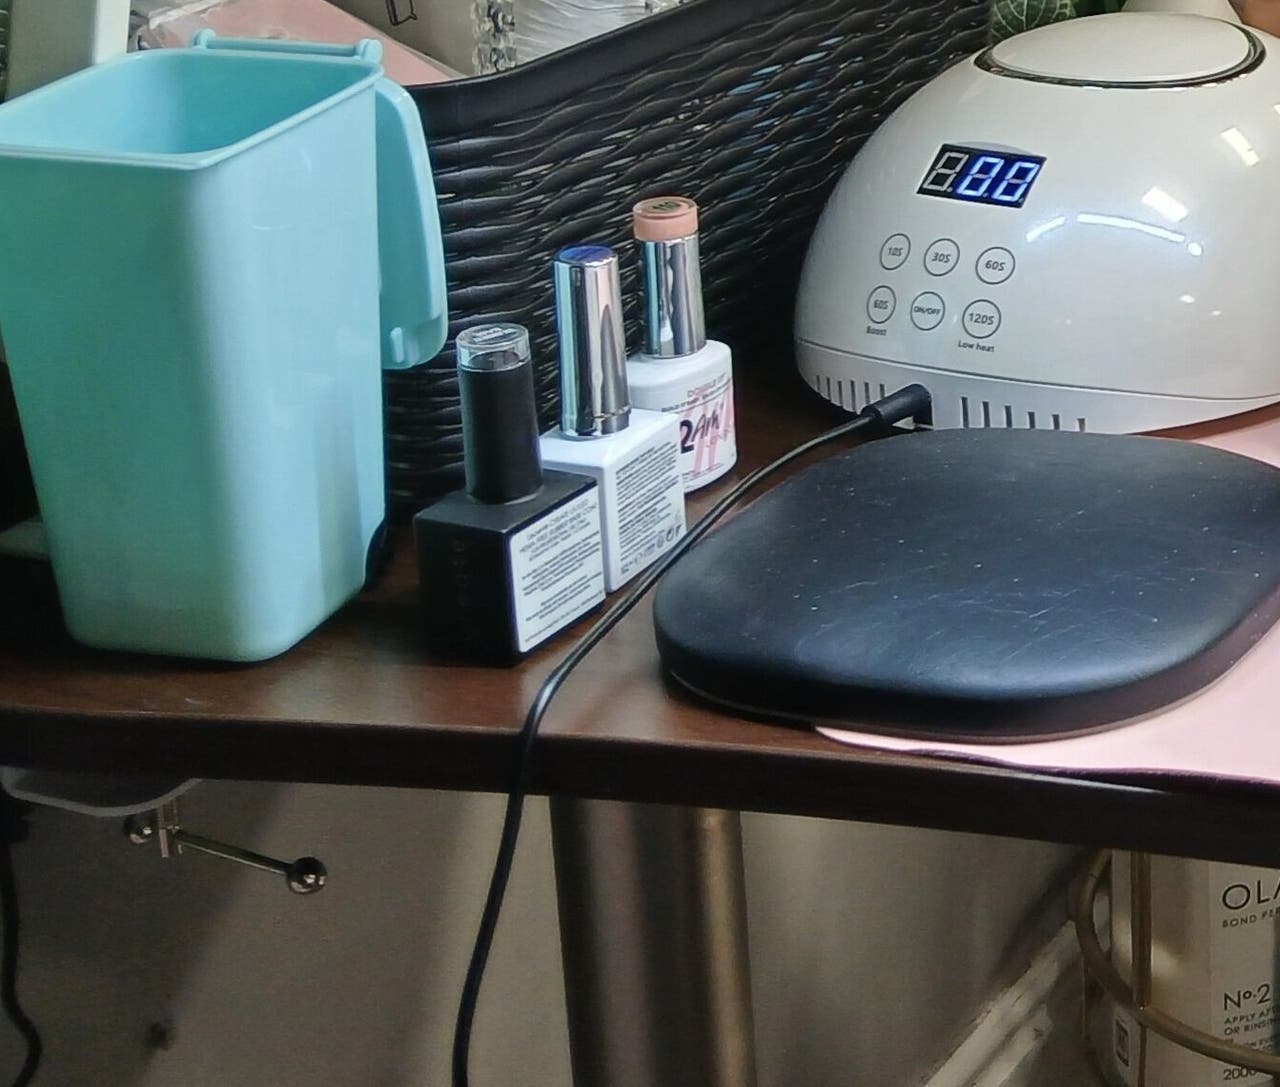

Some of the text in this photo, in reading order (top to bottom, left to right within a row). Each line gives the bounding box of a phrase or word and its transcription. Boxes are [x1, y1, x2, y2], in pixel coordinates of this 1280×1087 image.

[985, 259, 1006, 272] 60S
[968, 312, 995, 326] 120S
[957, 339, 995, 353] Low heat
[1222, 914, 1257, 929] BOND
[1224, 1013, 1256, 1025] APPLY
[1223, 1026, 1241, 1037] OR
